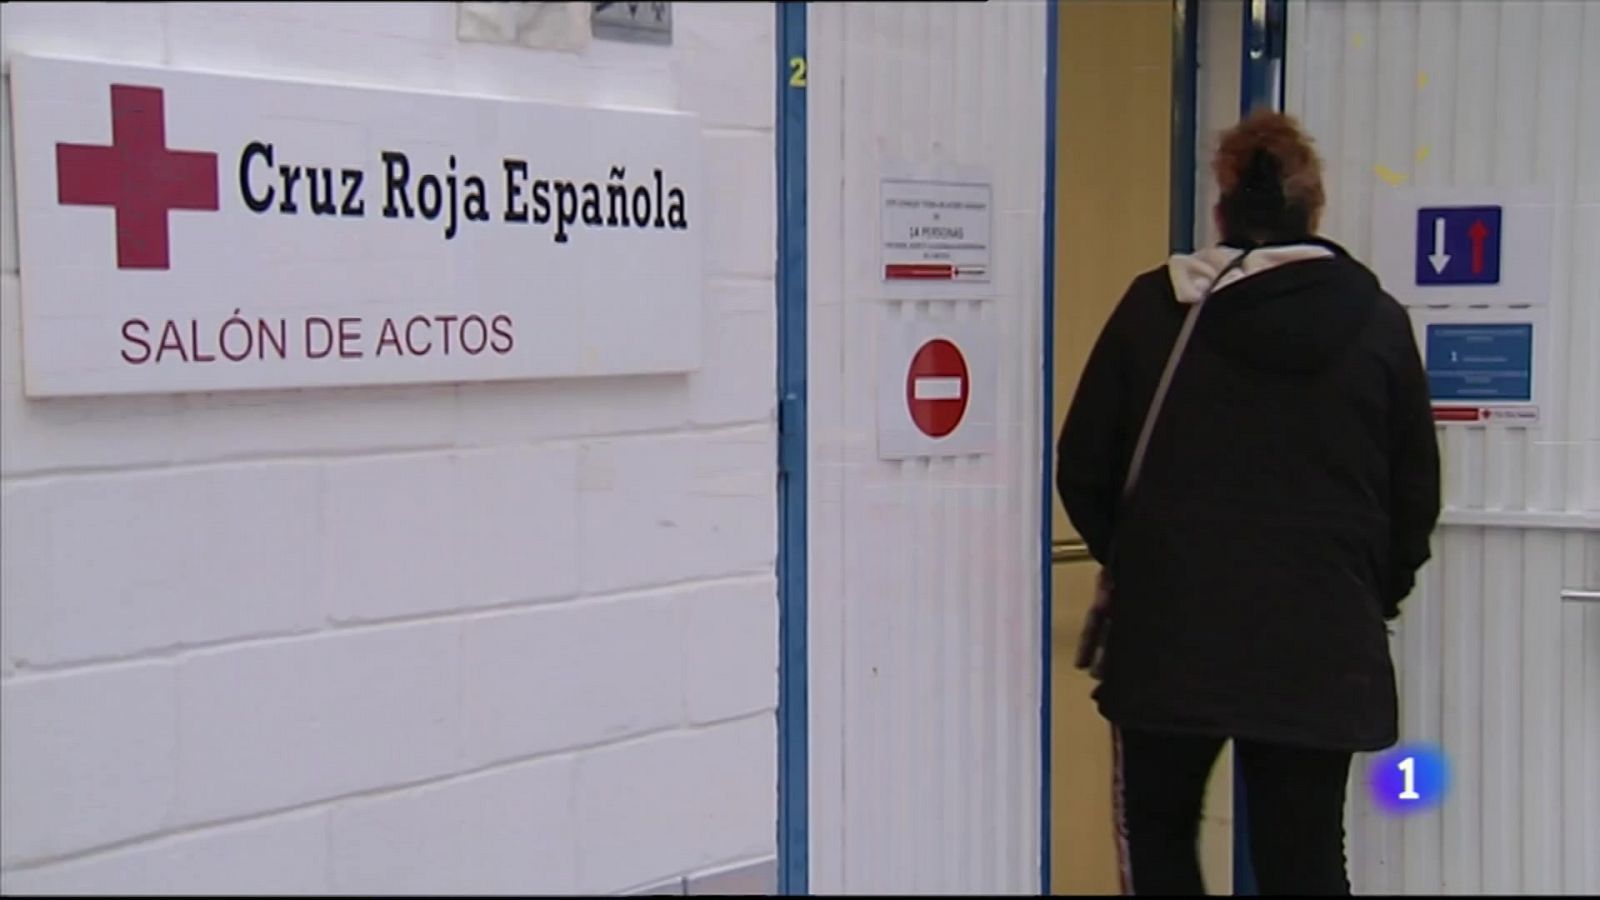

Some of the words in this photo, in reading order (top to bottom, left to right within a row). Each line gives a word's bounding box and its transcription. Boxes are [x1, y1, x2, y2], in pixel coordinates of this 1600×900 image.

[790, 56, 807, 87] 2
[239, 141, 365, 217] Cruz
[381, 150, 490, 240] Roja
[503, 159, 688, 244] Española
[120, 307, 287, 365] SALÓN
[305, 316, 364, 359] DE
[375, 314, 514, 357] ACTOS
